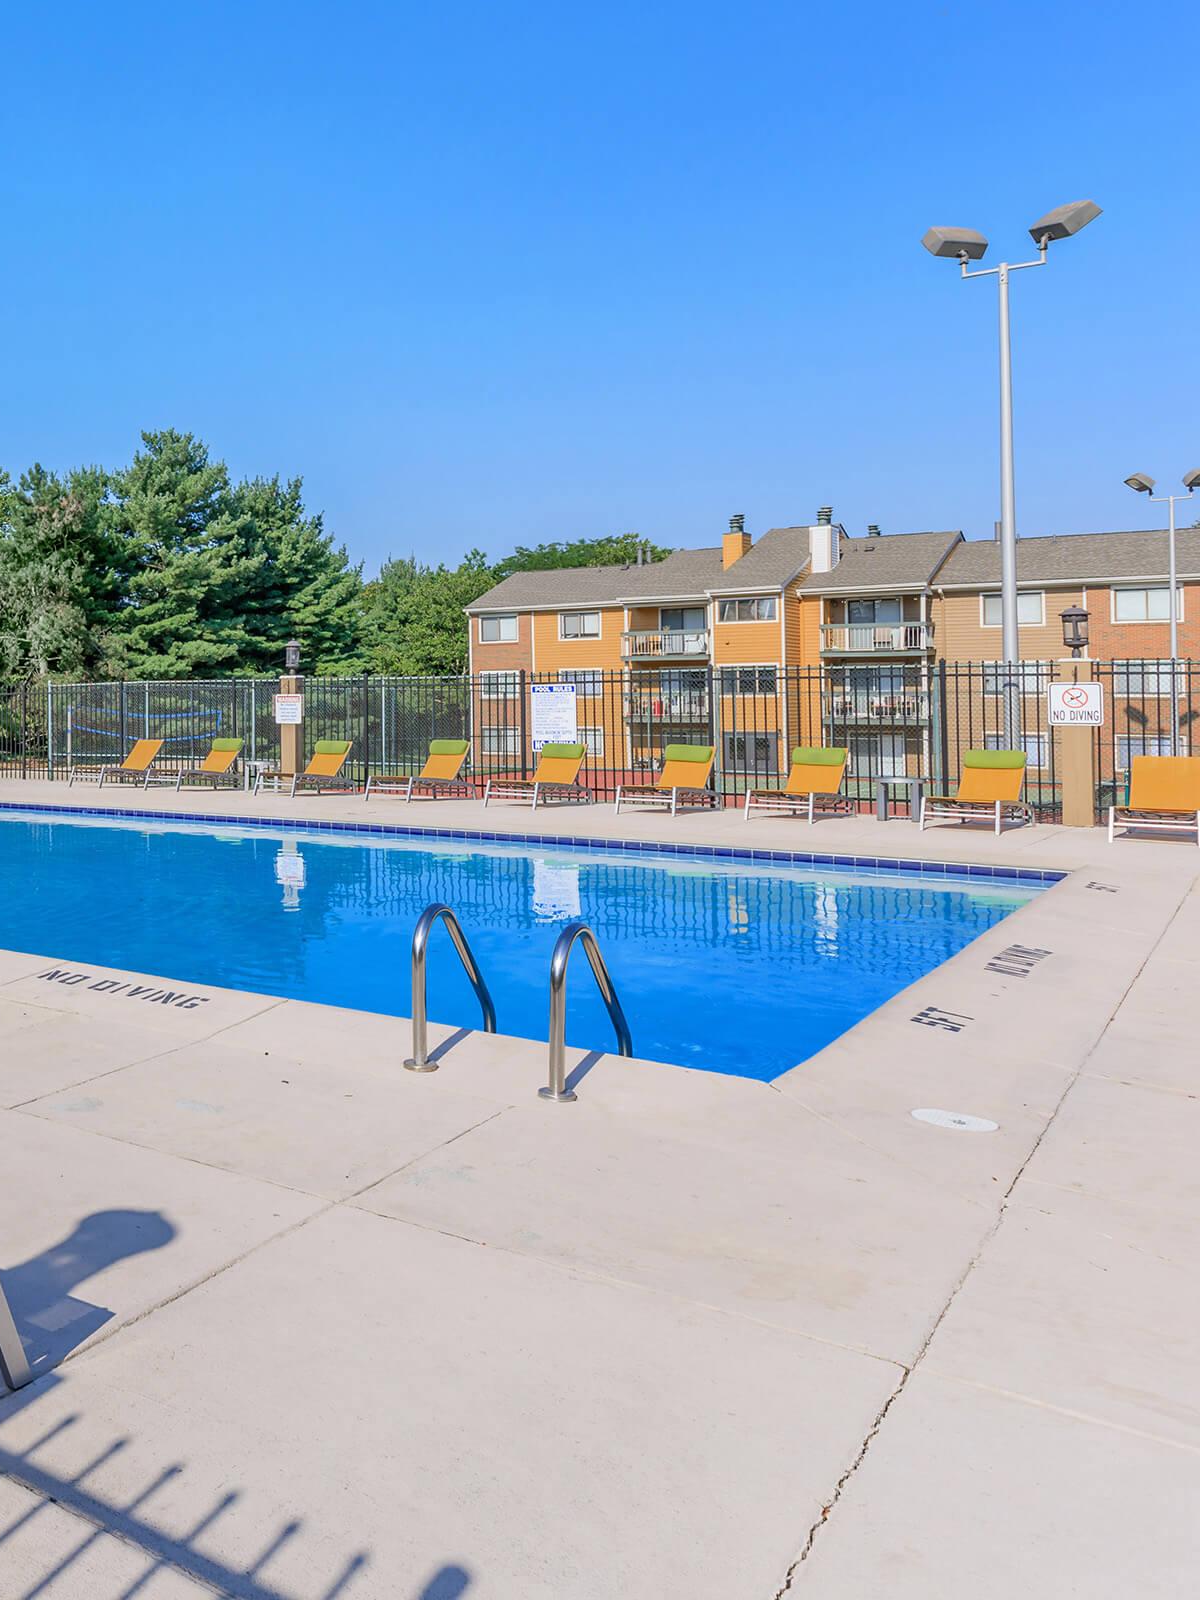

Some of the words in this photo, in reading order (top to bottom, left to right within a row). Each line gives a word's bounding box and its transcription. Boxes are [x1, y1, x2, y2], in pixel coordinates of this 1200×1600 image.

[1053, 710, 1066, 721] NO
[1070, 710, 1100, 721] DIVING
[37, 969, 92, 986] NO
[87, 979, 211, 1010] DIVING
[910, 1006, 976, 1033] 5FT
